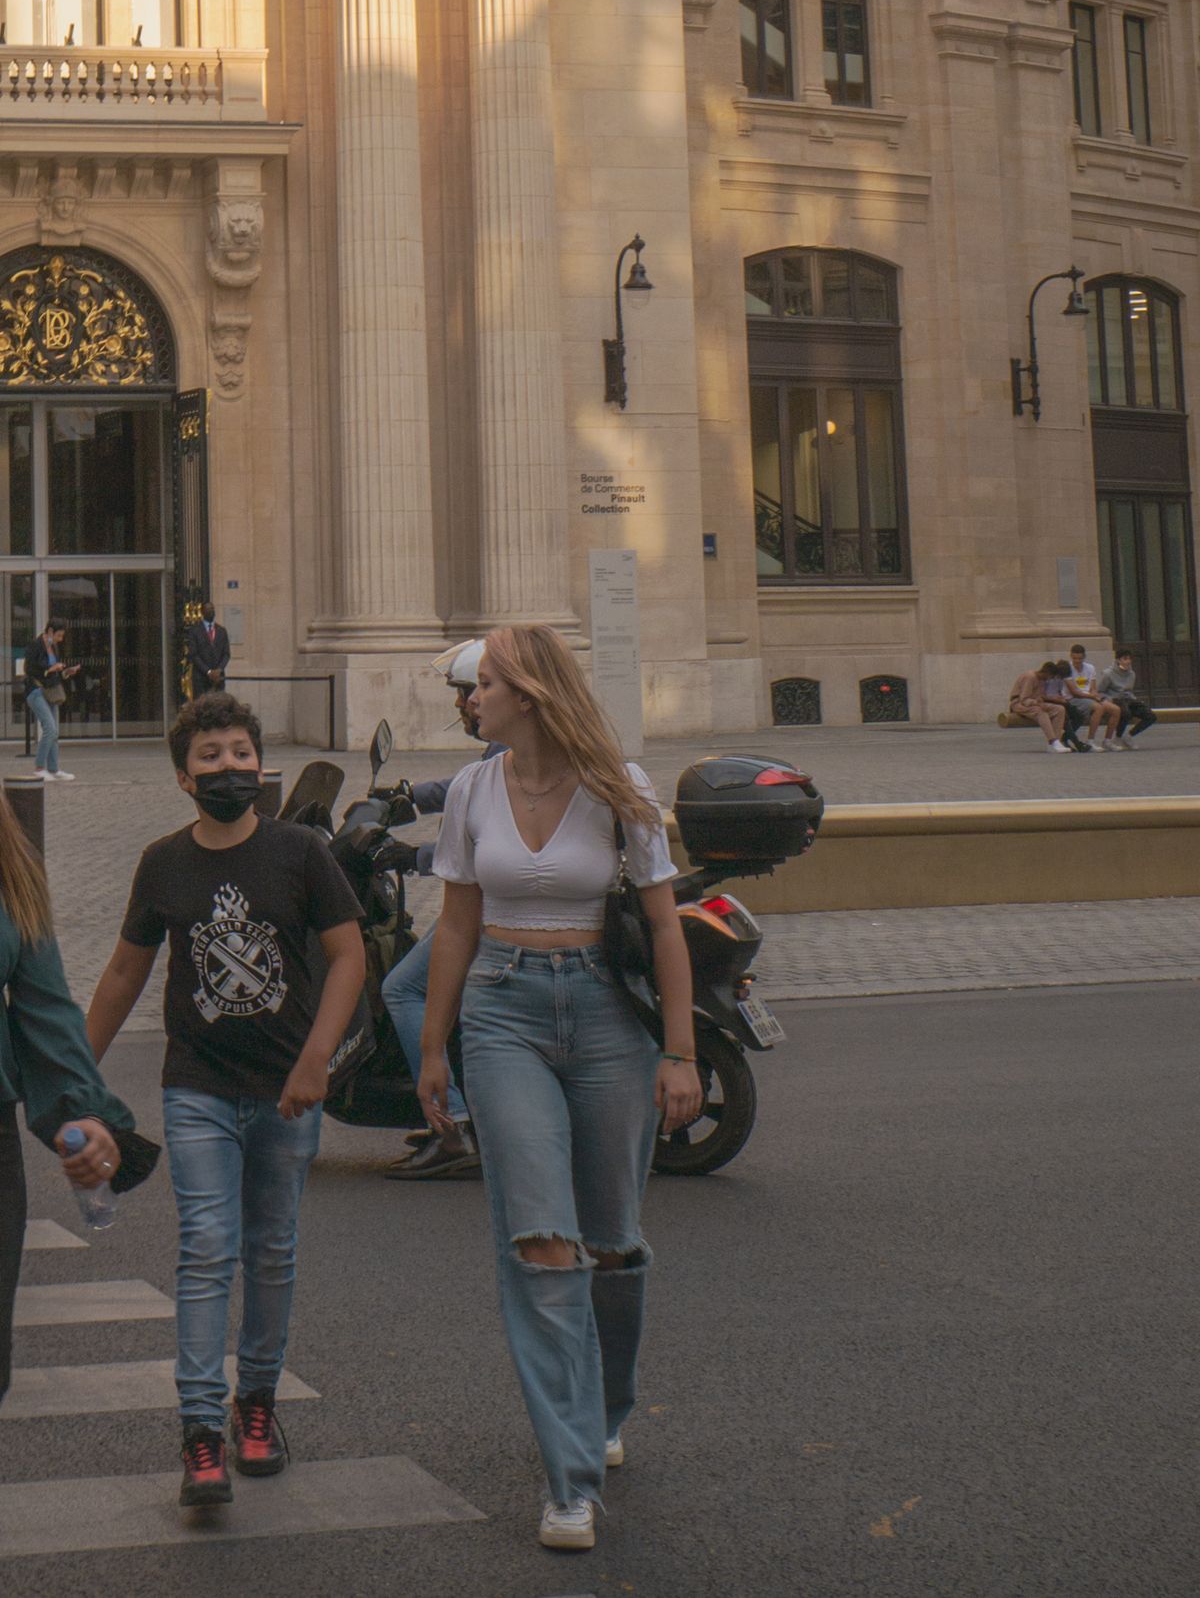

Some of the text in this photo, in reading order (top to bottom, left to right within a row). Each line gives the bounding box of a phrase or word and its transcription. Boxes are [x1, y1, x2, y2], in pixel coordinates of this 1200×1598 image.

[581, 473, 614, 483] Bourse
[581, 484, 645, 493] de Commerce
[611, 494, 645, 503] Pinault
[581, 504, 630, 514] Collection
[209, 922, 241, 937] FIELD
[211, 994, 254, 1013] DEPUIS
